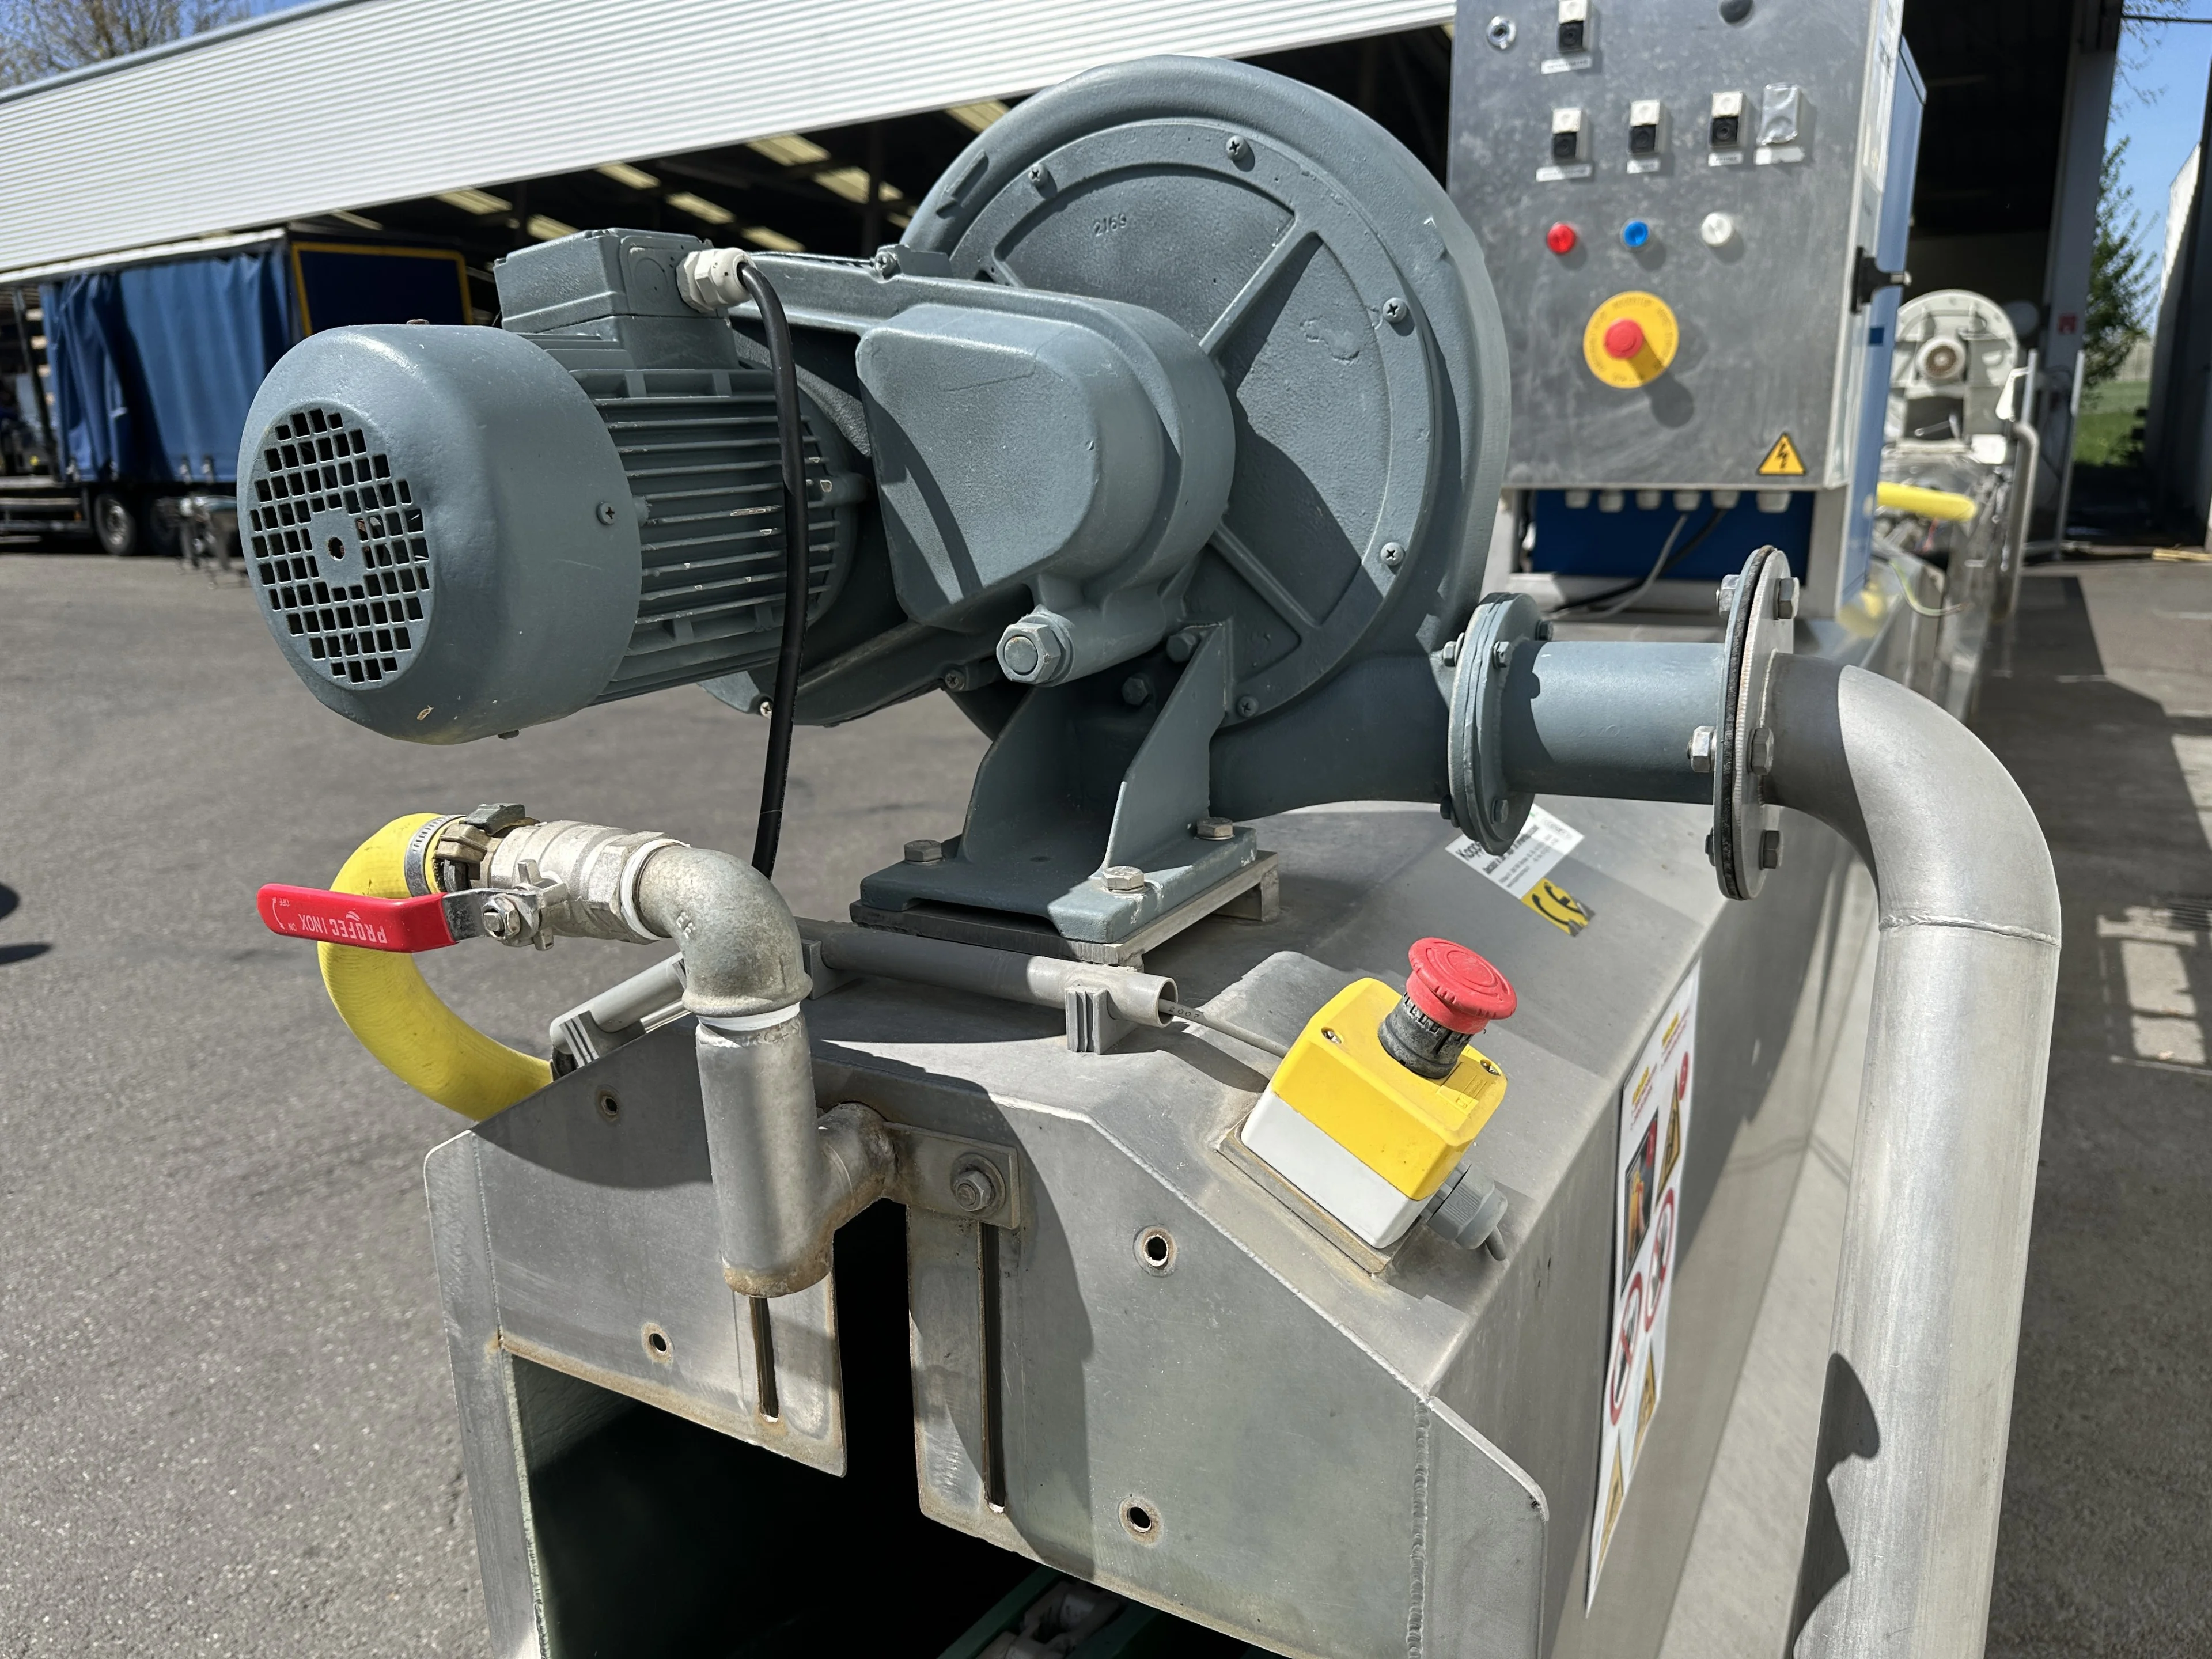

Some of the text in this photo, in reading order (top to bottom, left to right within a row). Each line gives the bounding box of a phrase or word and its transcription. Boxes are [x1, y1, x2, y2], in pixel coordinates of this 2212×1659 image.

[279, 897, 290, 907] OFF
[287, 922, 297, 931] ON
[298, 914, 388, 944] PROFEC INOX
[1168, 1006, 1200, 1019] 2007
